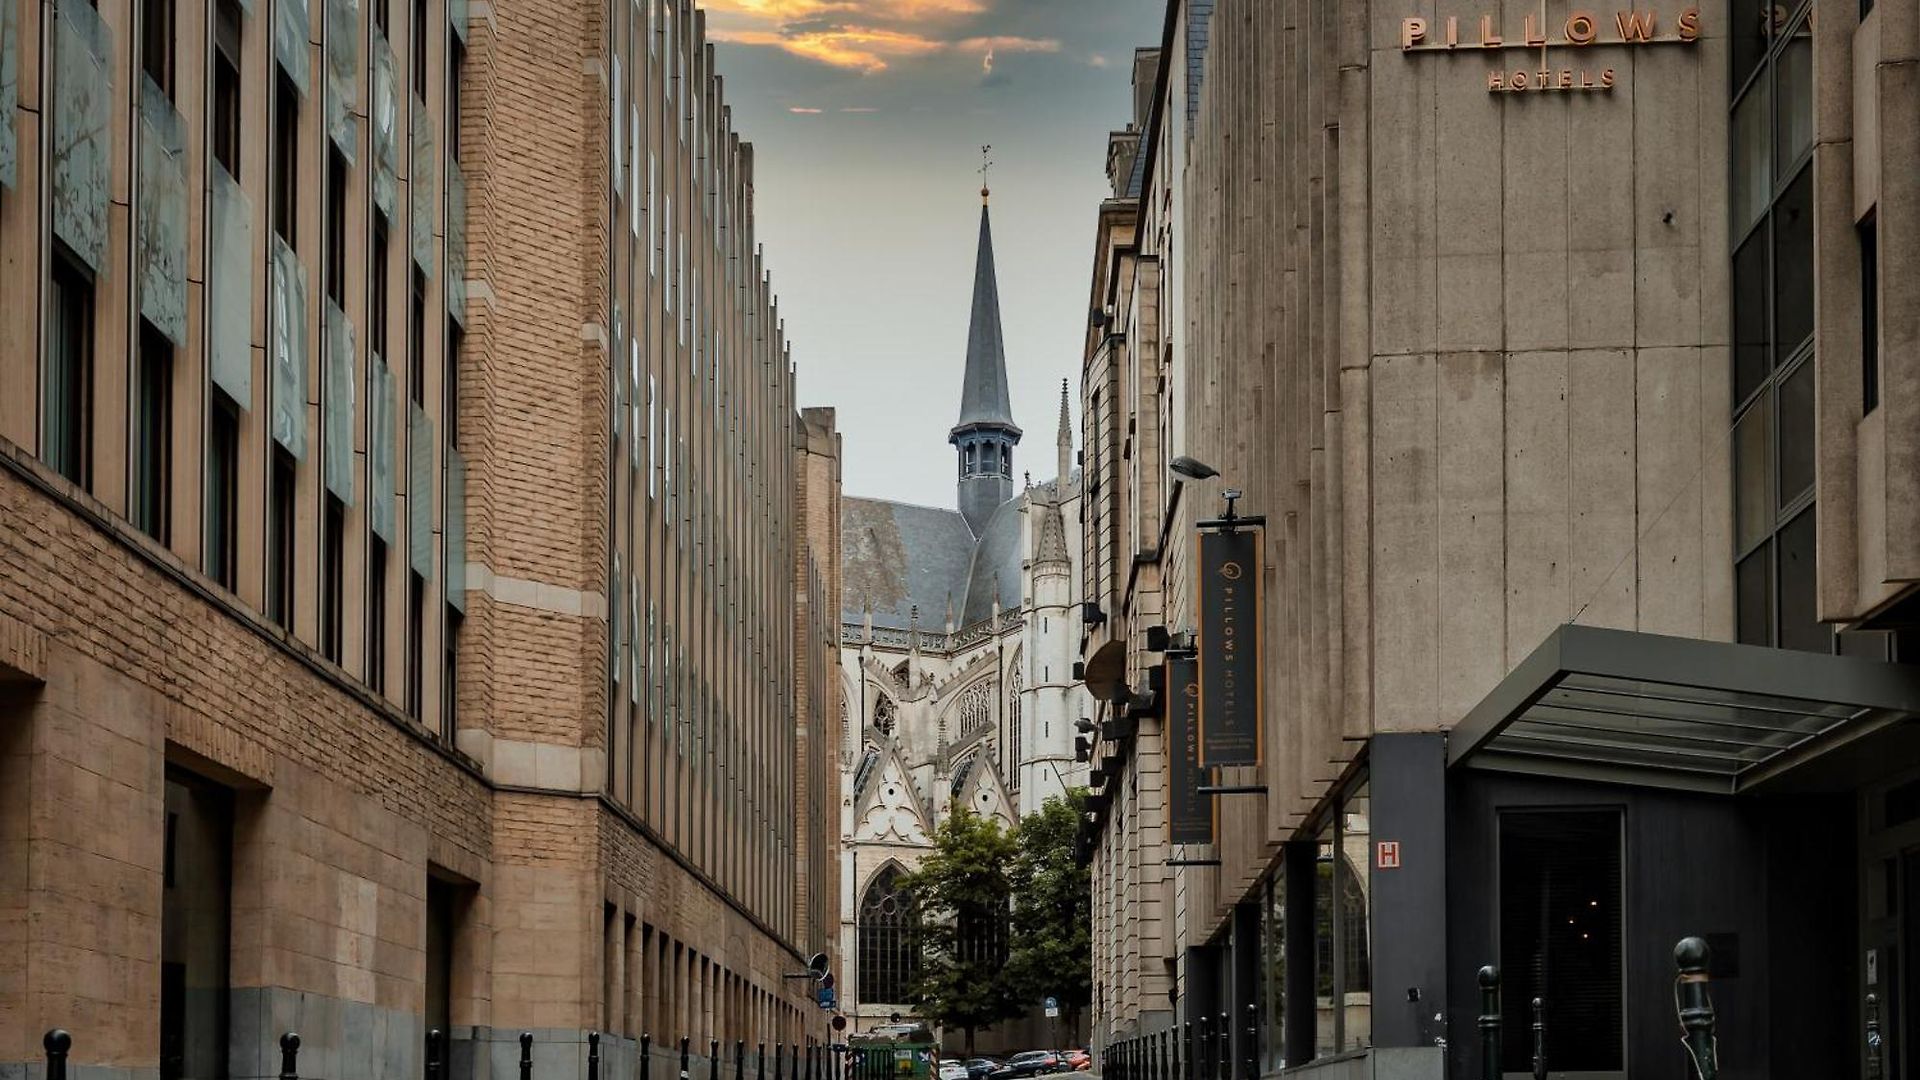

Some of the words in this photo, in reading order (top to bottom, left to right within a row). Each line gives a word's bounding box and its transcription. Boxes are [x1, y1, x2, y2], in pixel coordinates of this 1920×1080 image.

[1402, 8, 1699, 49] PILLOWS
[1488, 69, 1614, 91] HOTELS
[1224, 587, 1234, 661] PILLOWS
[1381, 844, 1396, 865] H
